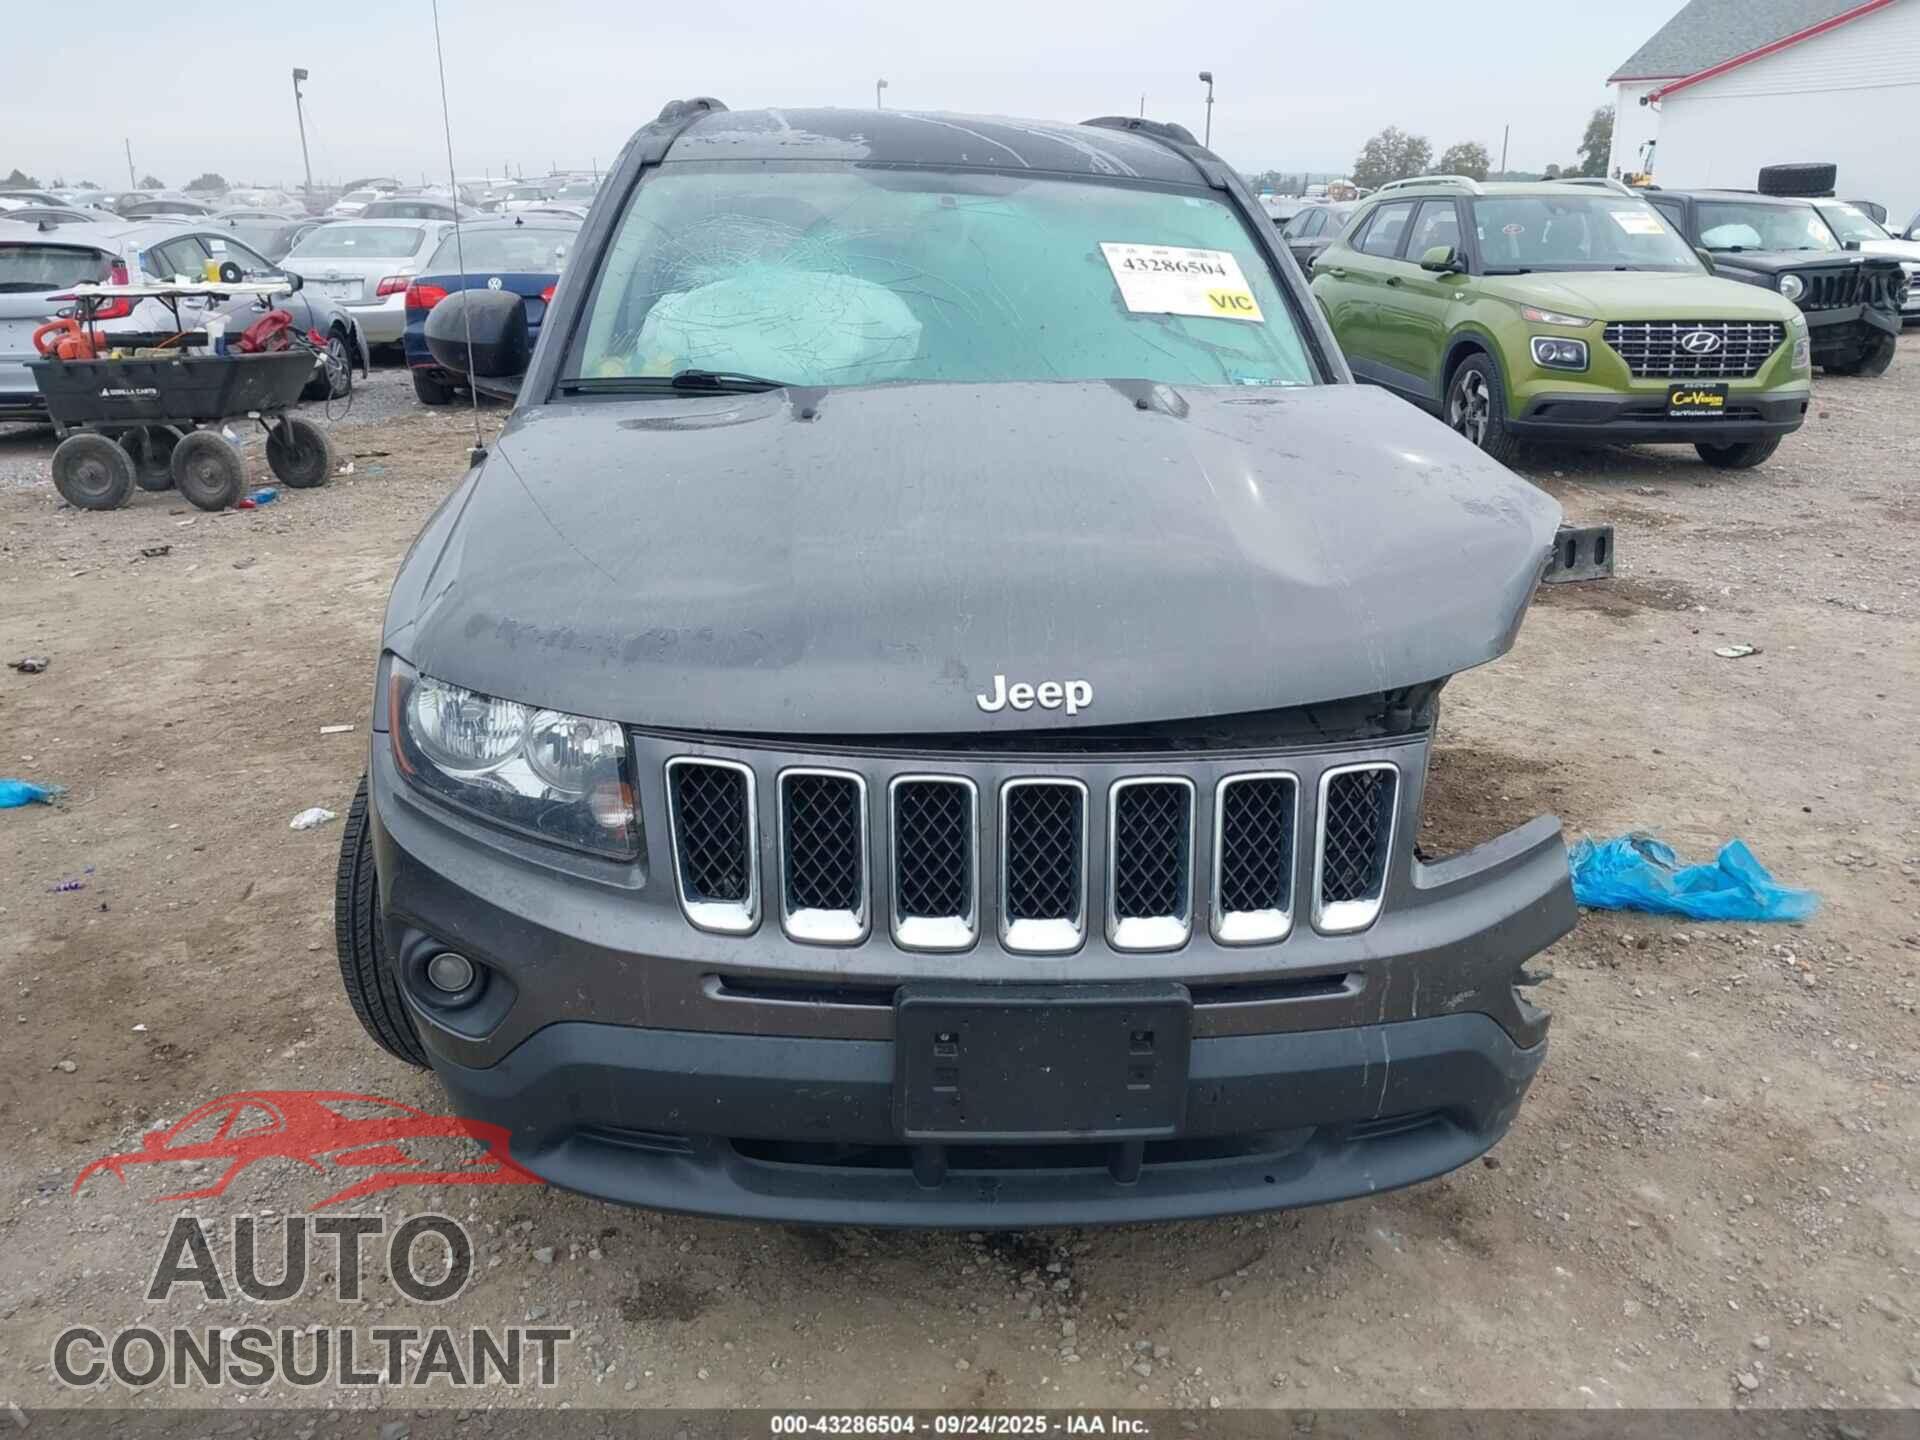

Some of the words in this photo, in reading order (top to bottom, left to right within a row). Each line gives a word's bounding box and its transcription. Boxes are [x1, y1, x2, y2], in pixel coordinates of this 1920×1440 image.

[1122, 257, 1227, 277] 43286504
[1208, 293, 1254, 311] VIC
[976, 674, 1094, 716] Jeep
